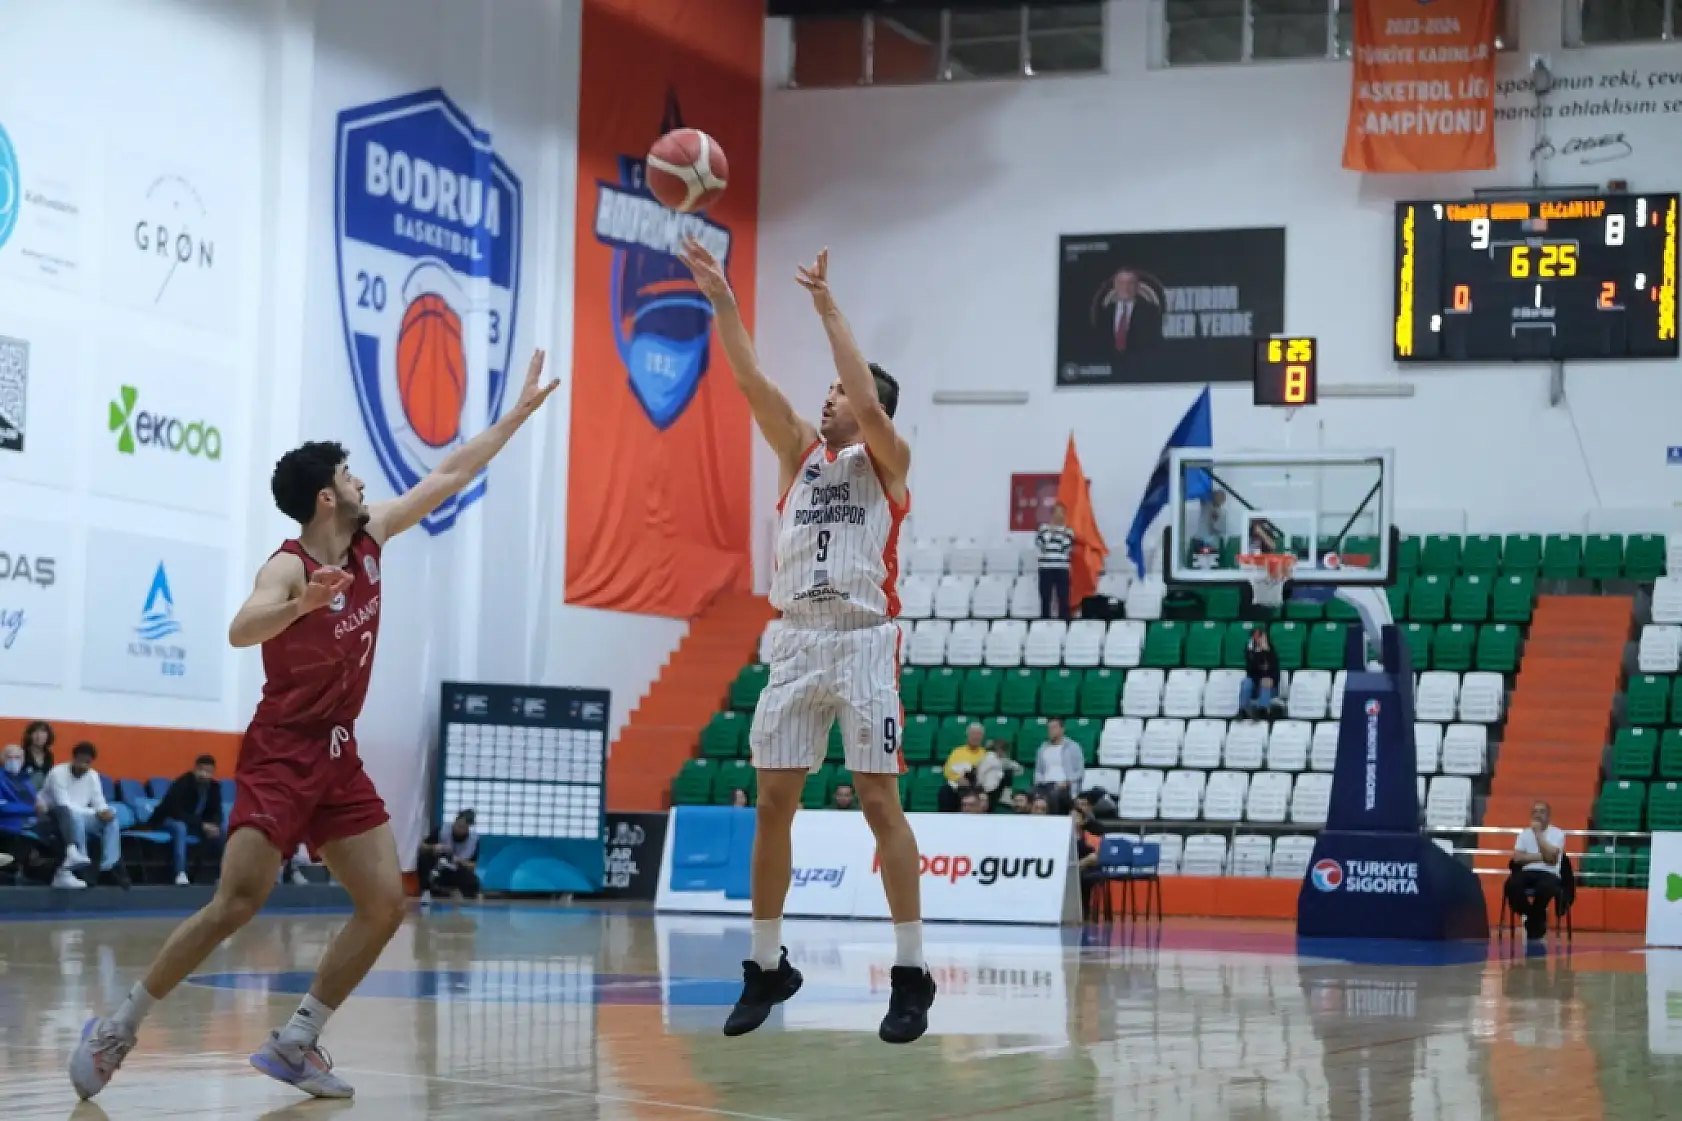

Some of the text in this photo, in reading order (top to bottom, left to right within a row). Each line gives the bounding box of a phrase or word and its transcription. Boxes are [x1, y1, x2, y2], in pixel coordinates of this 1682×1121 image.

[1600, 69, 1641, 89] zeki,
[1357, 103, 1487, 136] AMPİYONU
[1470, 218, 1490, 250] 9
[1605, 214, 1625, 246] 8
[1511, 246, 1577, 278] 6 25
[356, 270, 387, 312] 20
[1454, 285, 1470, 312] 0
[1601, 281, 1617, 308] 2
[1285, 366, 1307, 402] 8
[136, 411, 221, 460] ekoda
[817, 531, 831, 562] 9
[883, 717, 897, 754] 9
[872, 847, 1055, 884] kap.guru
[1346, 876, 1420, 895] SIGORTA
